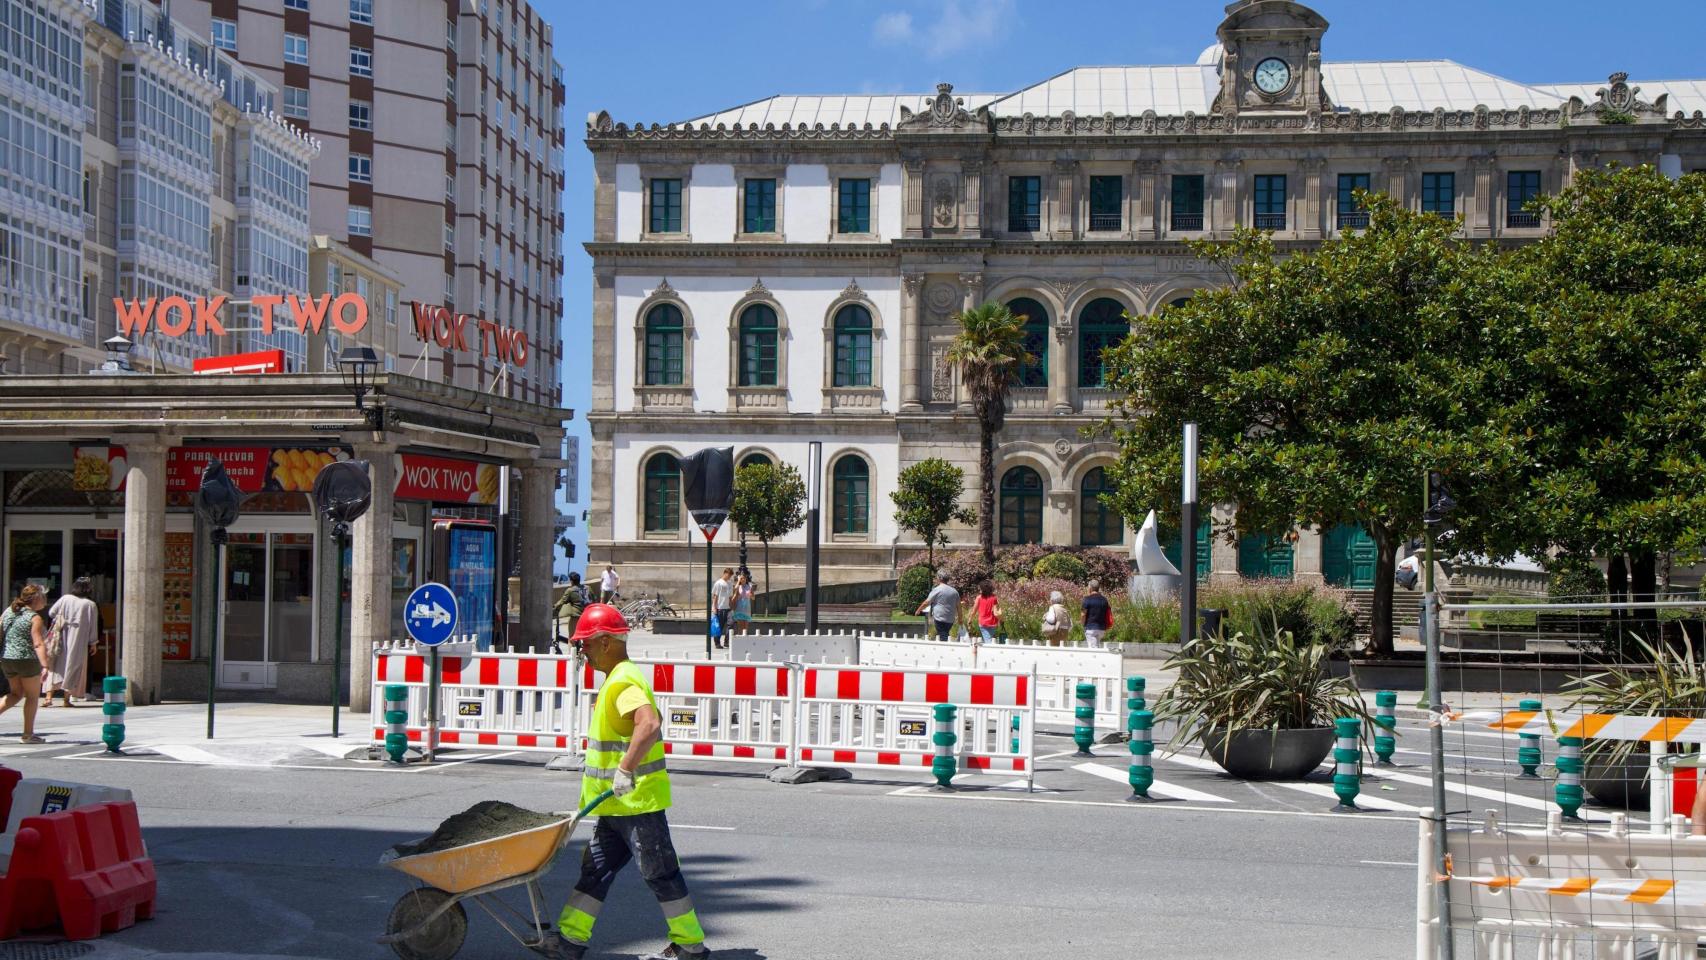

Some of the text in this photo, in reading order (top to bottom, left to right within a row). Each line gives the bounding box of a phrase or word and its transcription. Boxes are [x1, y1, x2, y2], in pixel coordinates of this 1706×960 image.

[1264, 119, 1277, 129] DE
[113, 292, 368, 337] WOK TWO
[410, 299, 528, 368] WOK TWO
[219, 451, 254, 462] LLEVAR
[568, 439, 577, 500] HOTEL
[405, 465, 472, 492] WOK TWO
